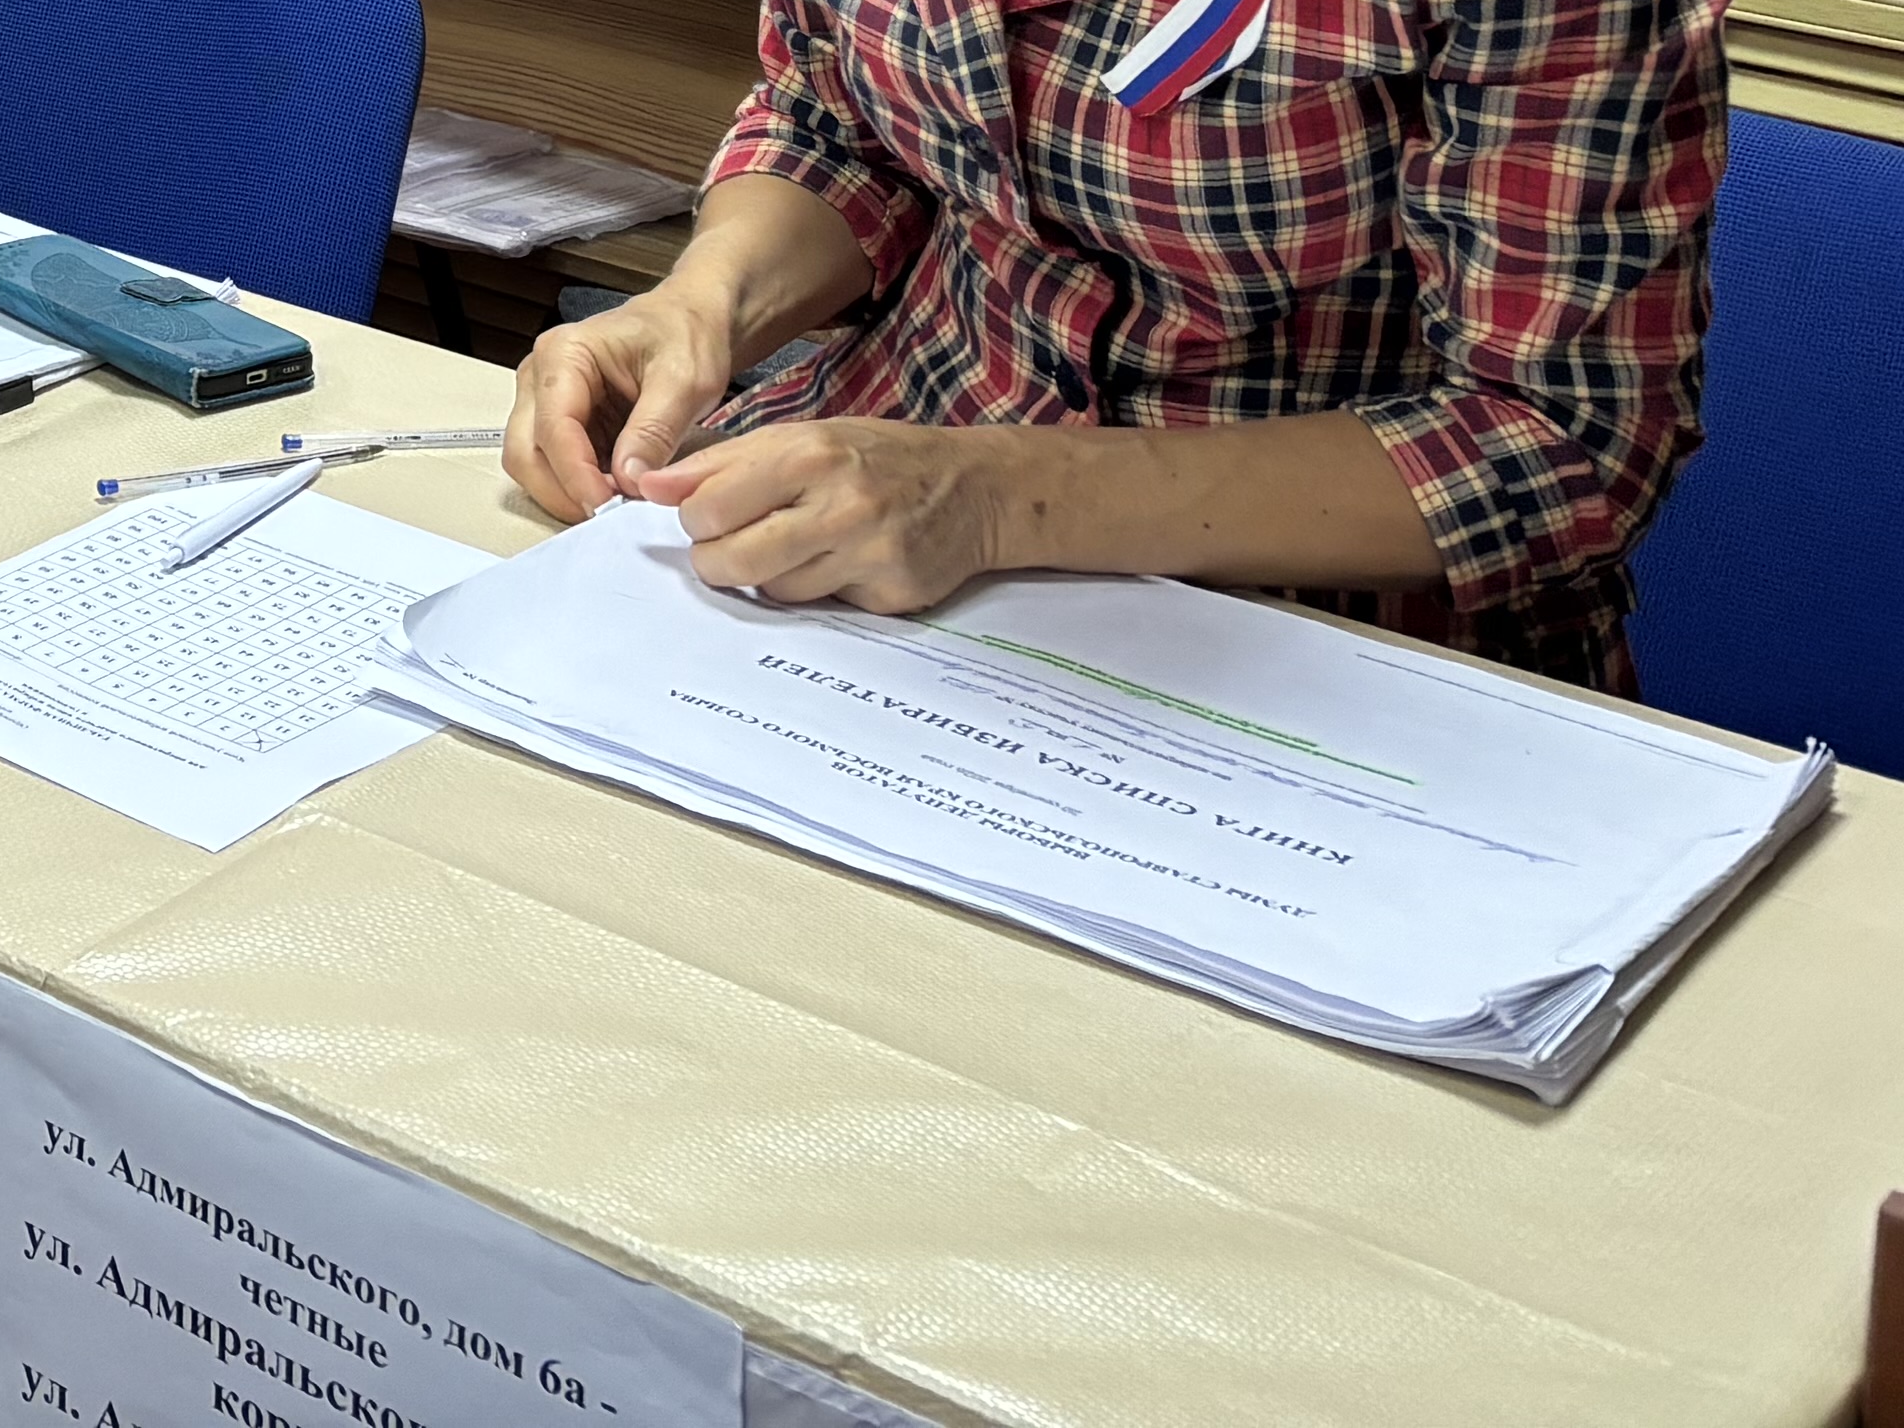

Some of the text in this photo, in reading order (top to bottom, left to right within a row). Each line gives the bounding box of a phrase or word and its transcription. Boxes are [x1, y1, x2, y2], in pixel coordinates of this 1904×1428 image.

[755, 654, 1026, 755] ИЗБИРАТЕЛЕЙ
[761, 722, 894, 778] ВОСЬМОГО
[1035, 751, 1199, 816] СПИСКА
[1213, 813, 1354, 866] КНИГА
[23, 1220, 83, 1277] ул.
[43, 1119, 96, 1168] ул.
[108, 1148, 433, 1341] Адмиральского,
[443, 1317, 526, 1380] дом
[239, 1272, 389, 1369] четные
[21, 1362, 80, 1420] ул.
